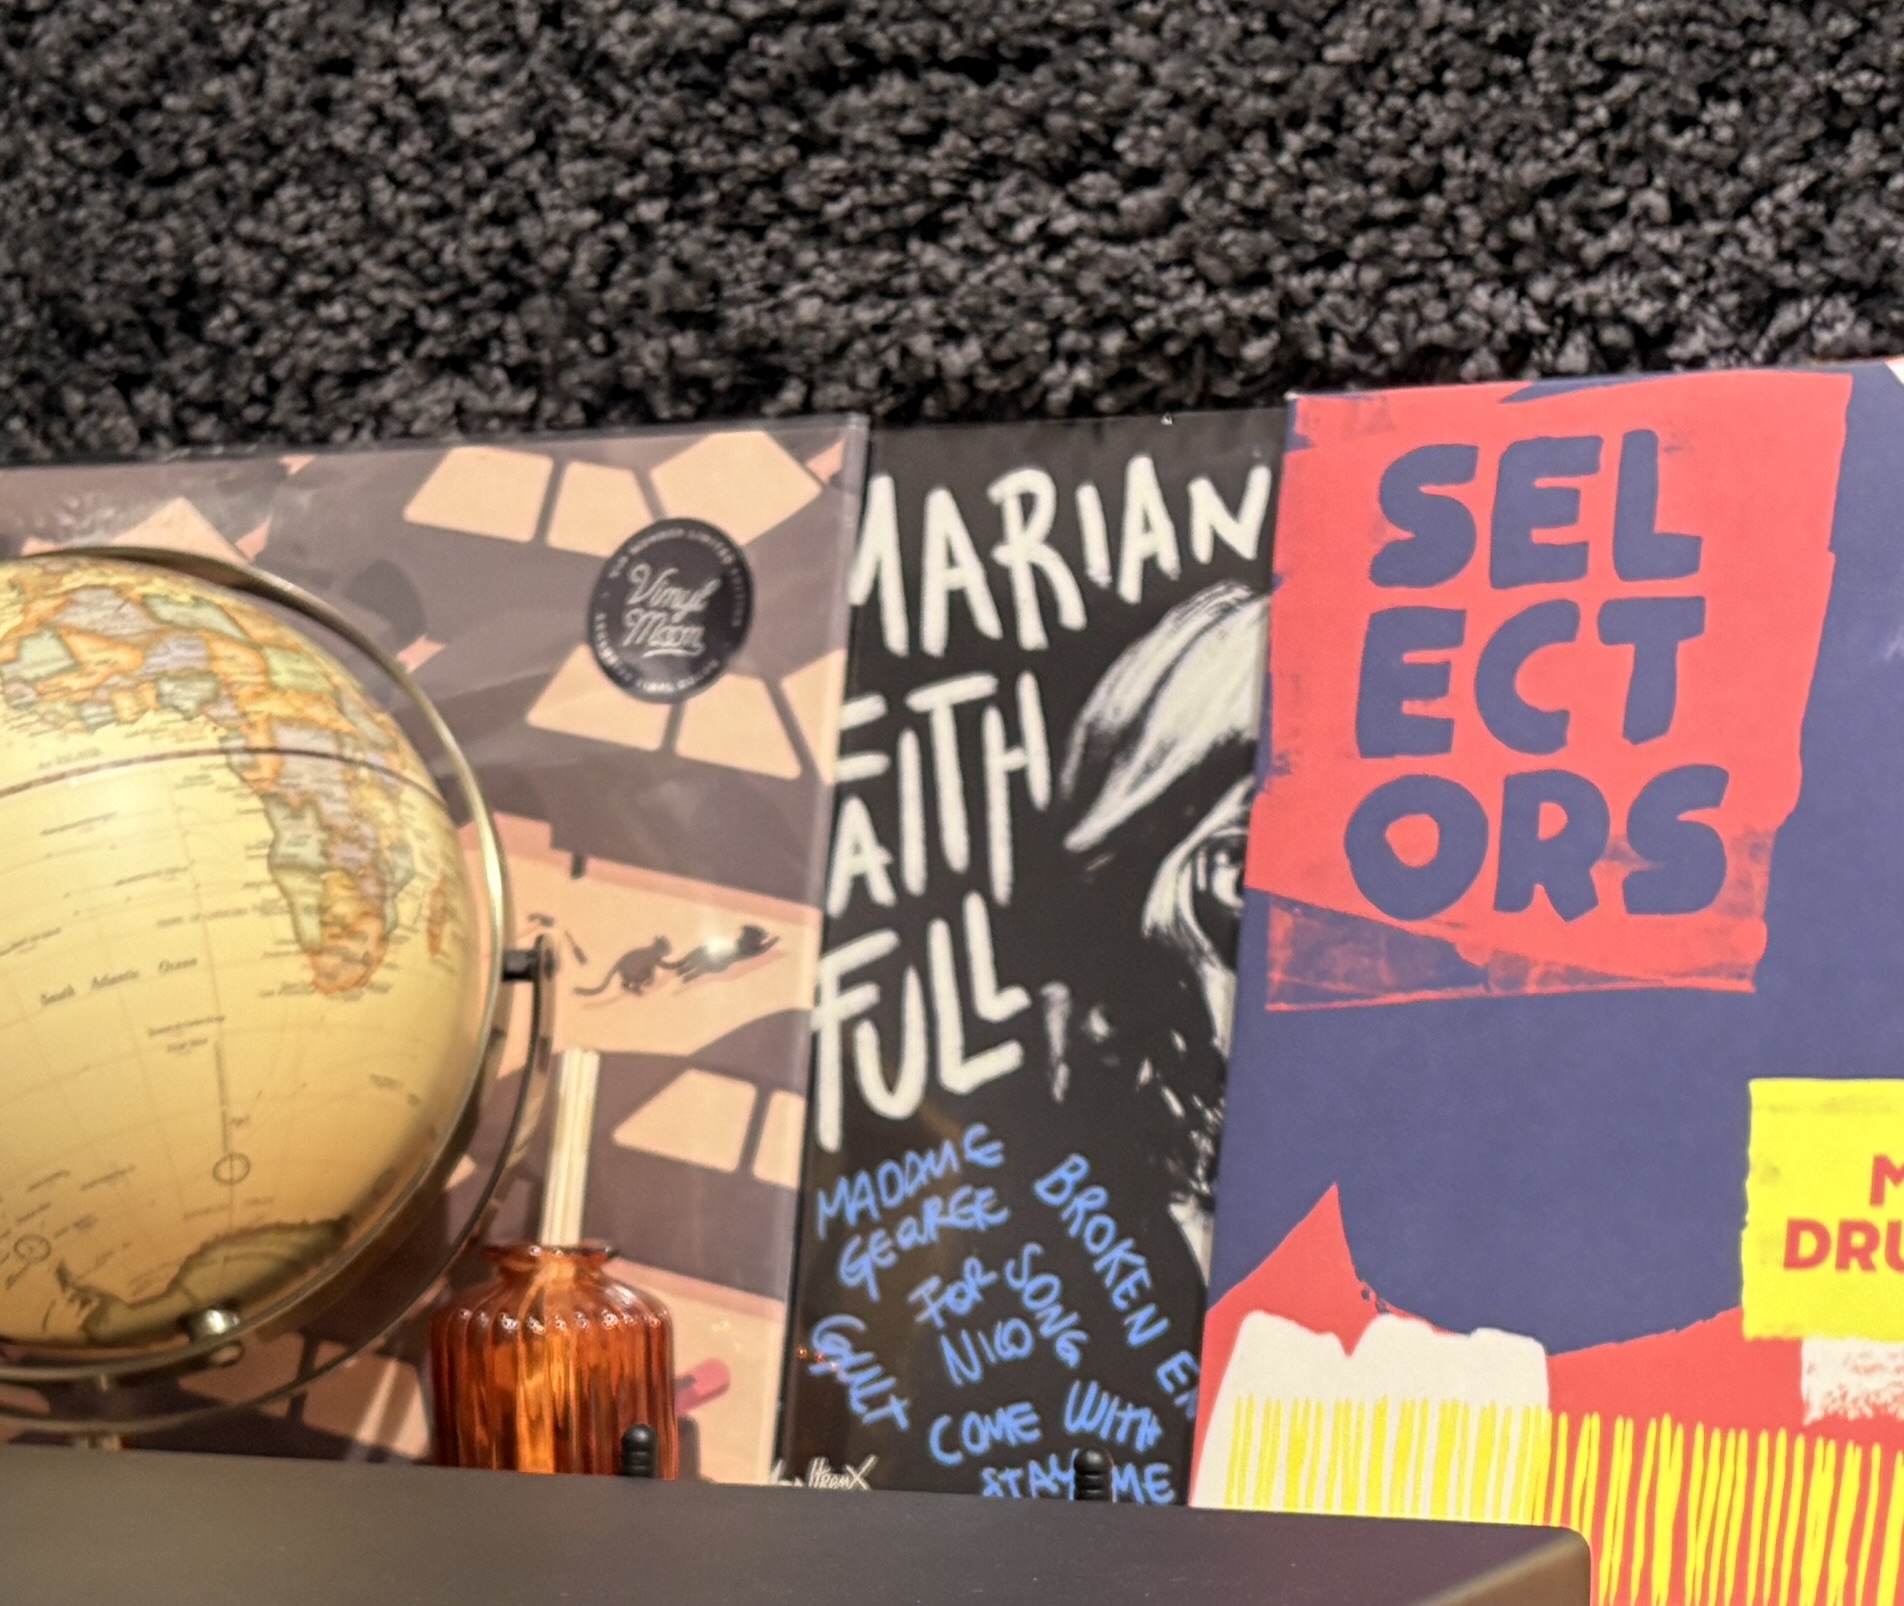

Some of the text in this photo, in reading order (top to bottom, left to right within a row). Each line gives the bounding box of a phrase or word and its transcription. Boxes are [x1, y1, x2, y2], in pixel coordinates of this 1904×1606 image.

[1369, 429, 1703, 590] SEL
[623, 608, 707, 658] Moon
[626, 563, 722, 623] Vinyl
[1355, 596, 1706, 759] ECT
[1343, 763, 1730, 923] ORS
[1034, 1152, 1171, 1348] BROKEN
[928, 1401, 1041, 1464] COME
[1110, 1462, 1175, 1505] ME
